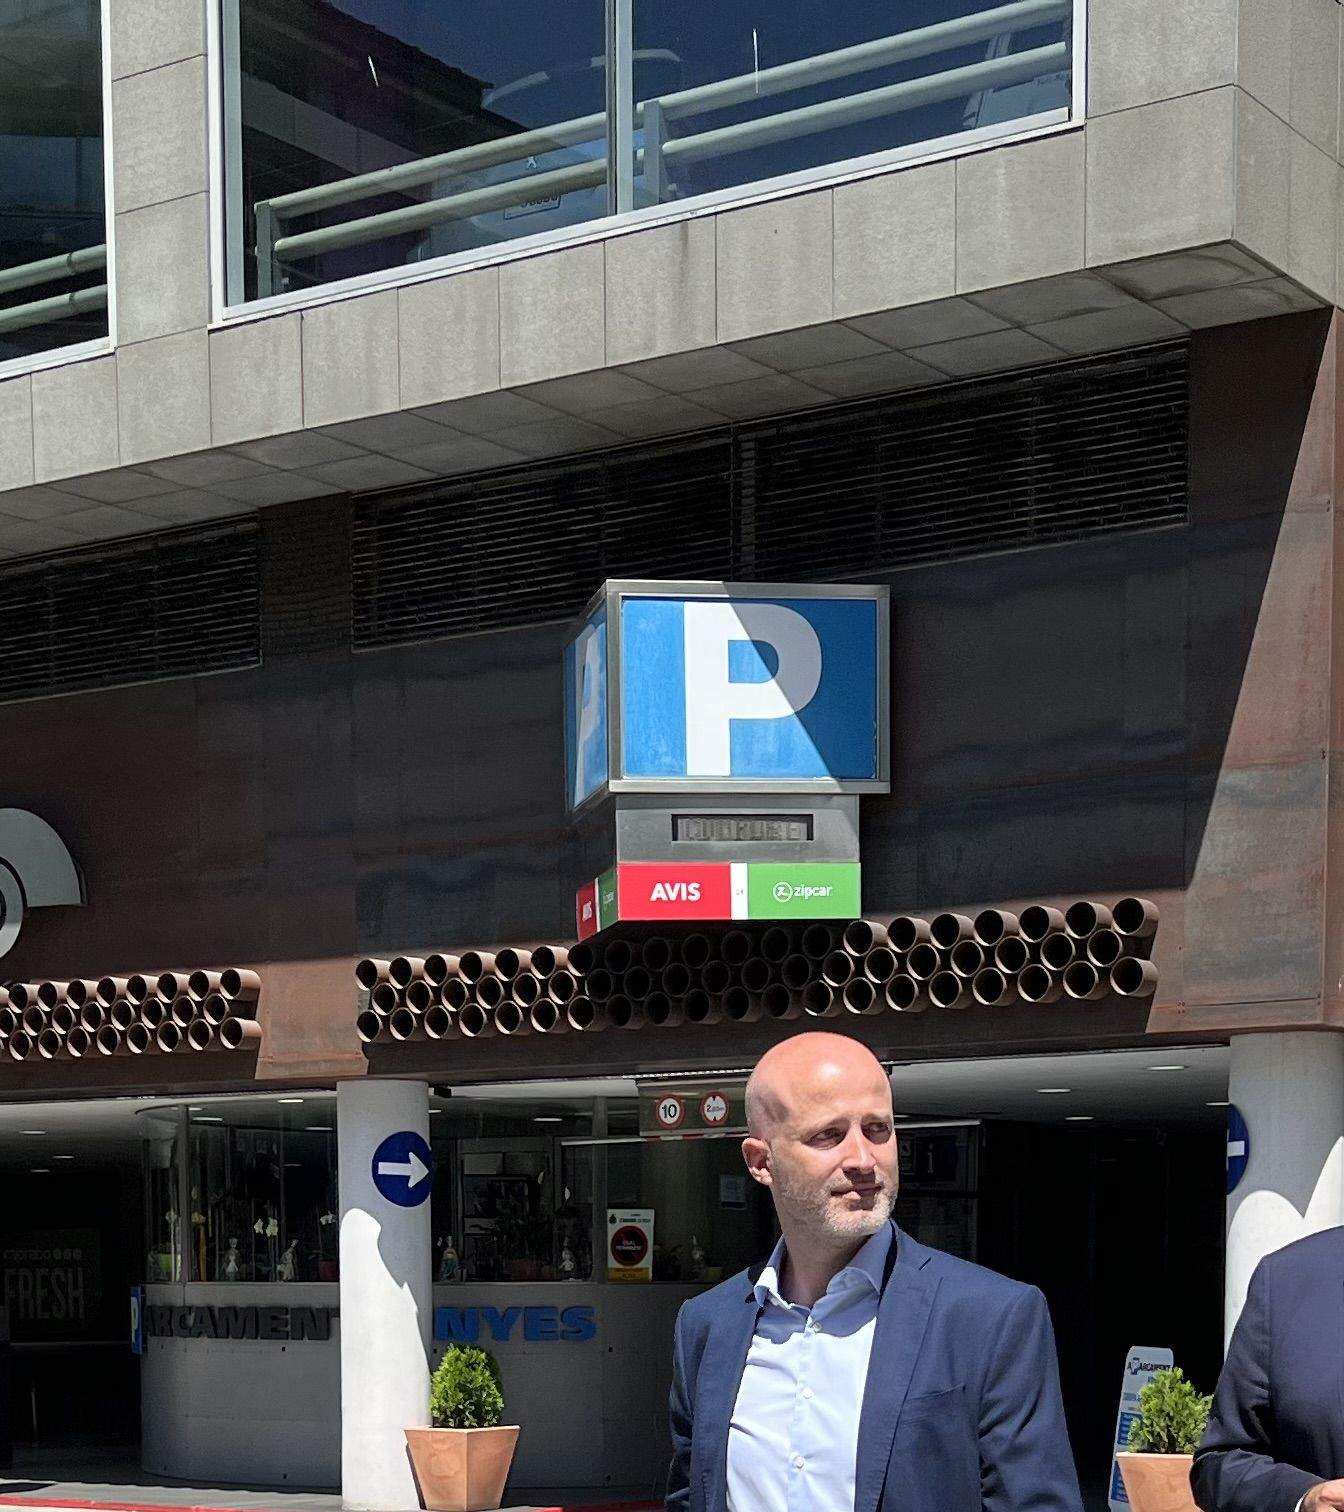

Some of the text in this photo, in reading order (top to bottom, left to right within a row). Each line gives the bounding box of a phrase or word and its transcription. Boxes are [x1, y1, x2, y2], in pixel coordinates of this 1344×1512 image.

[683, 601, 822, 776] P
[650, 883, 701, 901] AVIS
[794, 884, 833, 898] zipcar
[662, 1104, 677, 1119] 10
[434, 1306, 597, 1341] NYES
